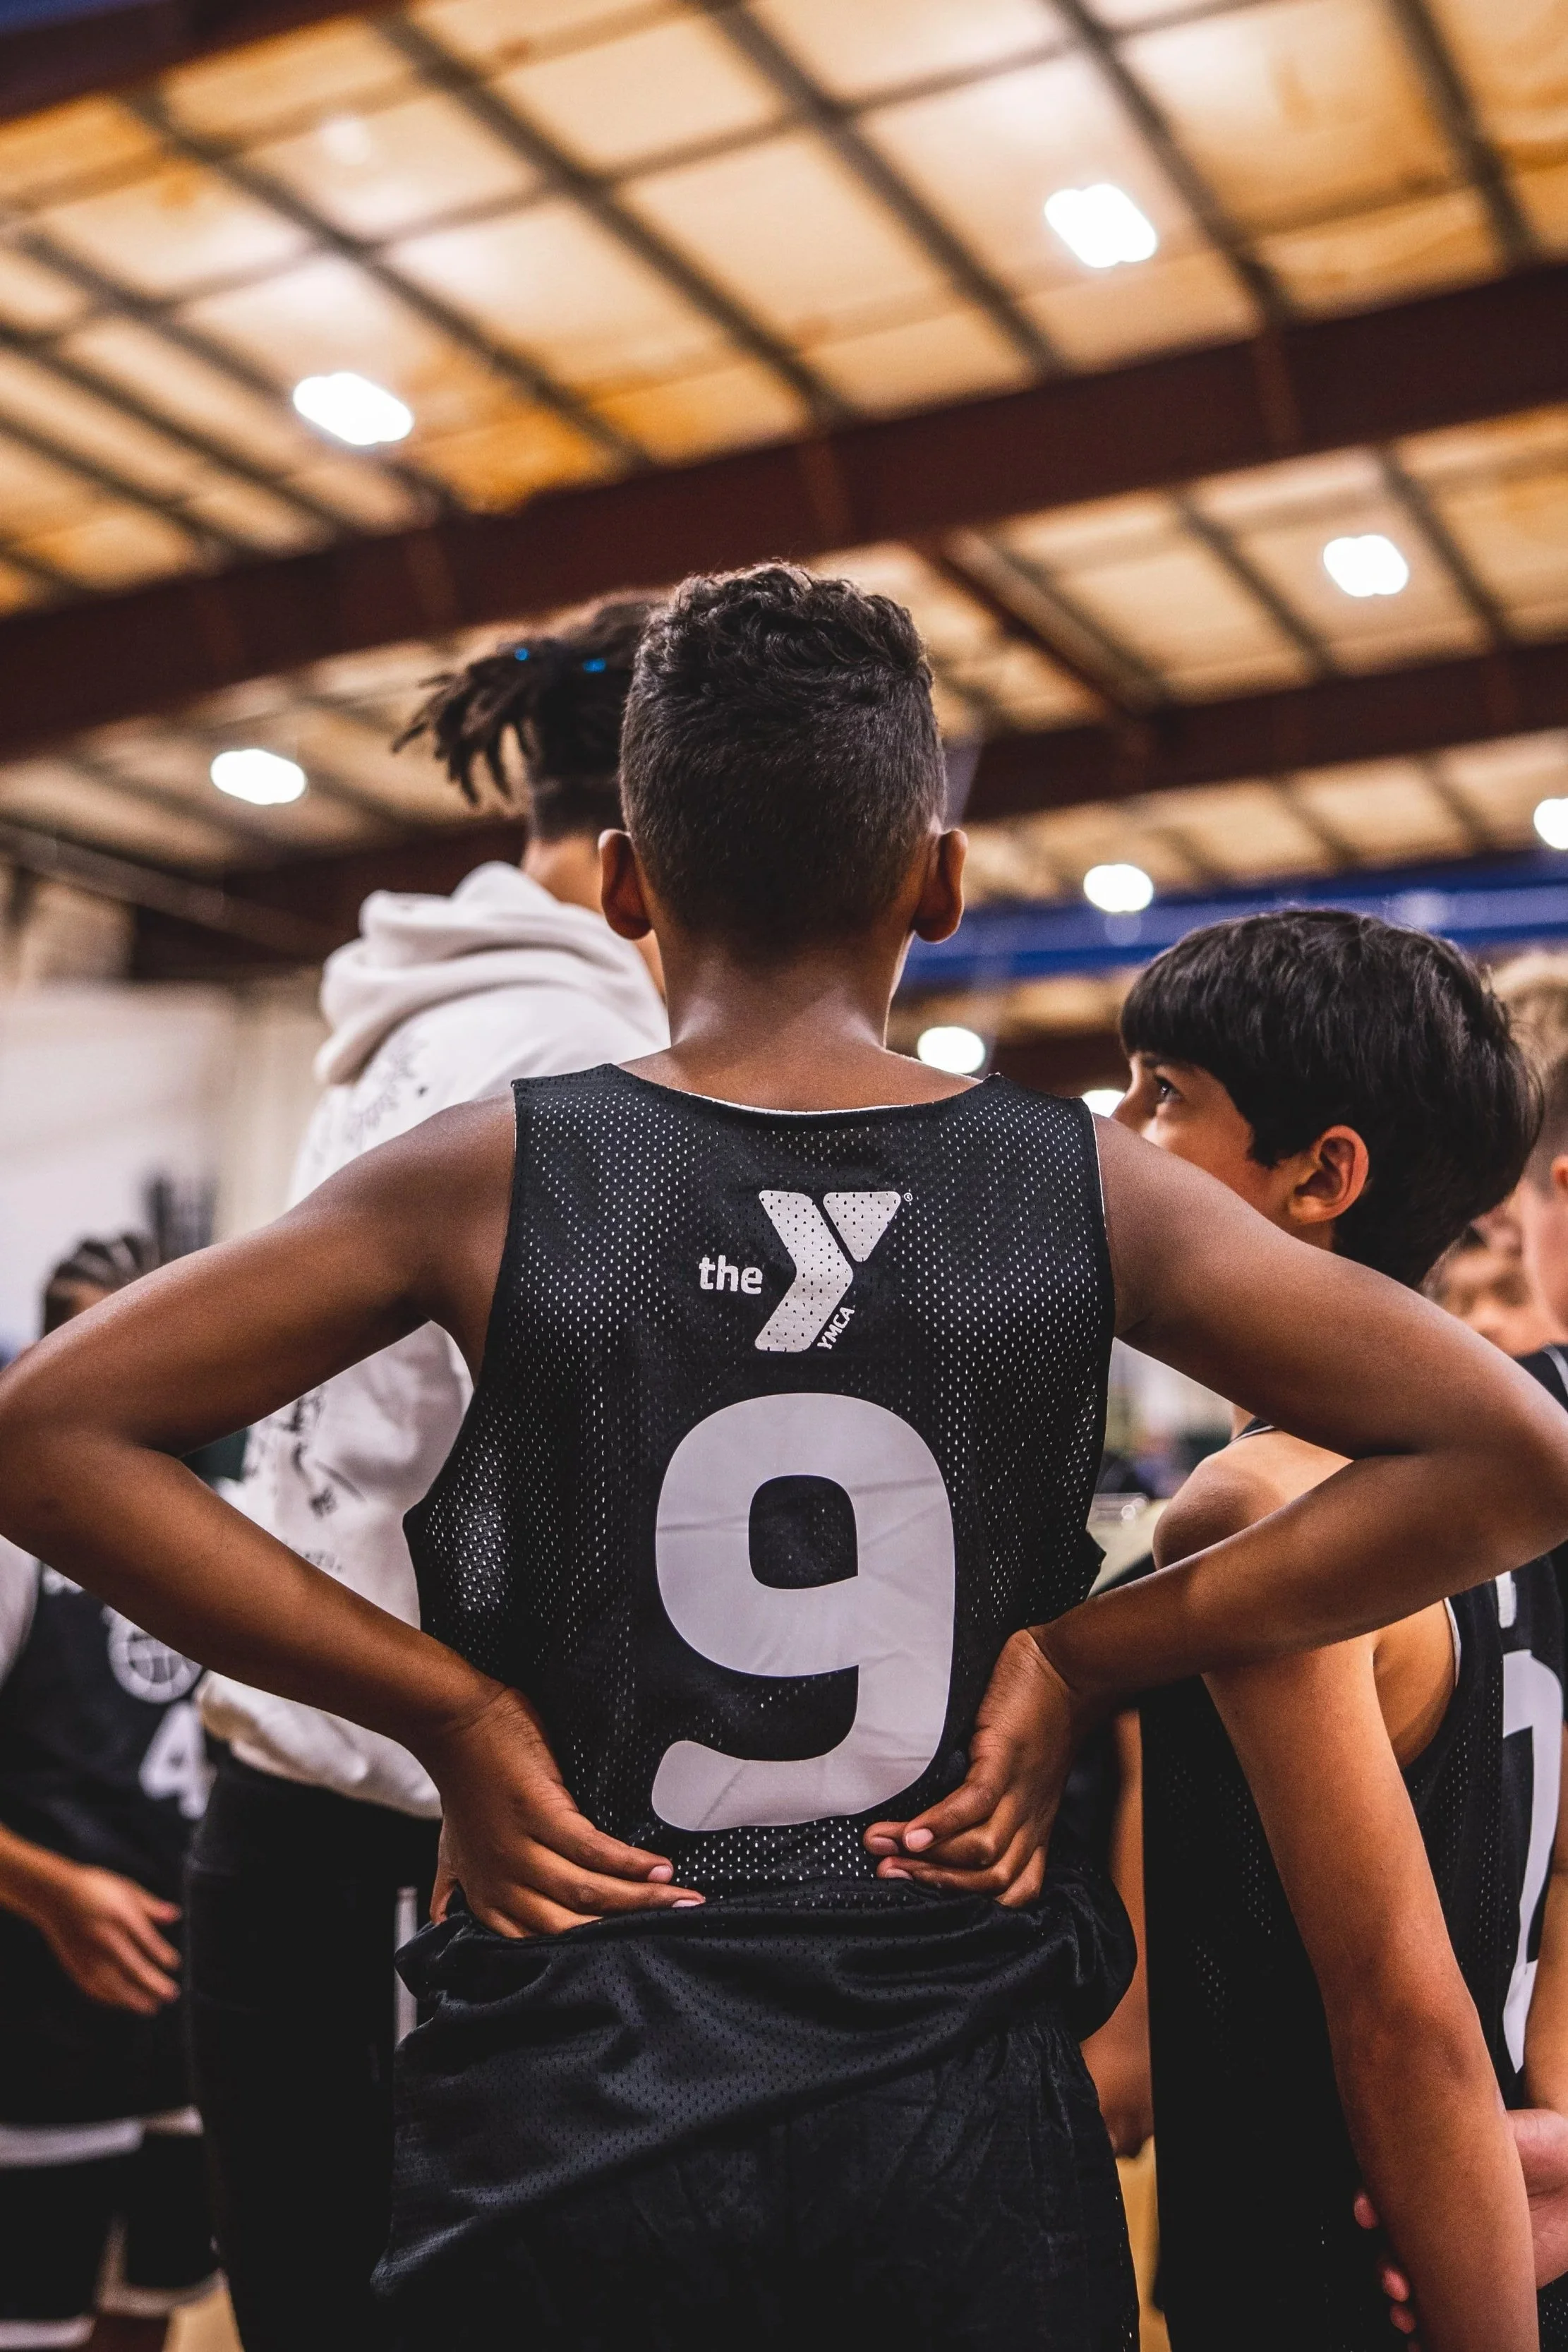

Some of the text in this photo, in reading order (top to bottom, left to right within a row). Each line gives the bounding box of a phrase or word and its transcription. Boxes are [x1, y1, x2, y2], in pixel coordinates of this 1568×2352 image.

[699, 1255, 764, 1295] the
[816, 1306, 855, 1351] YMCA
[651, 1392, 955, 1831] 9
[139, 1700, 217, 1821] 4
